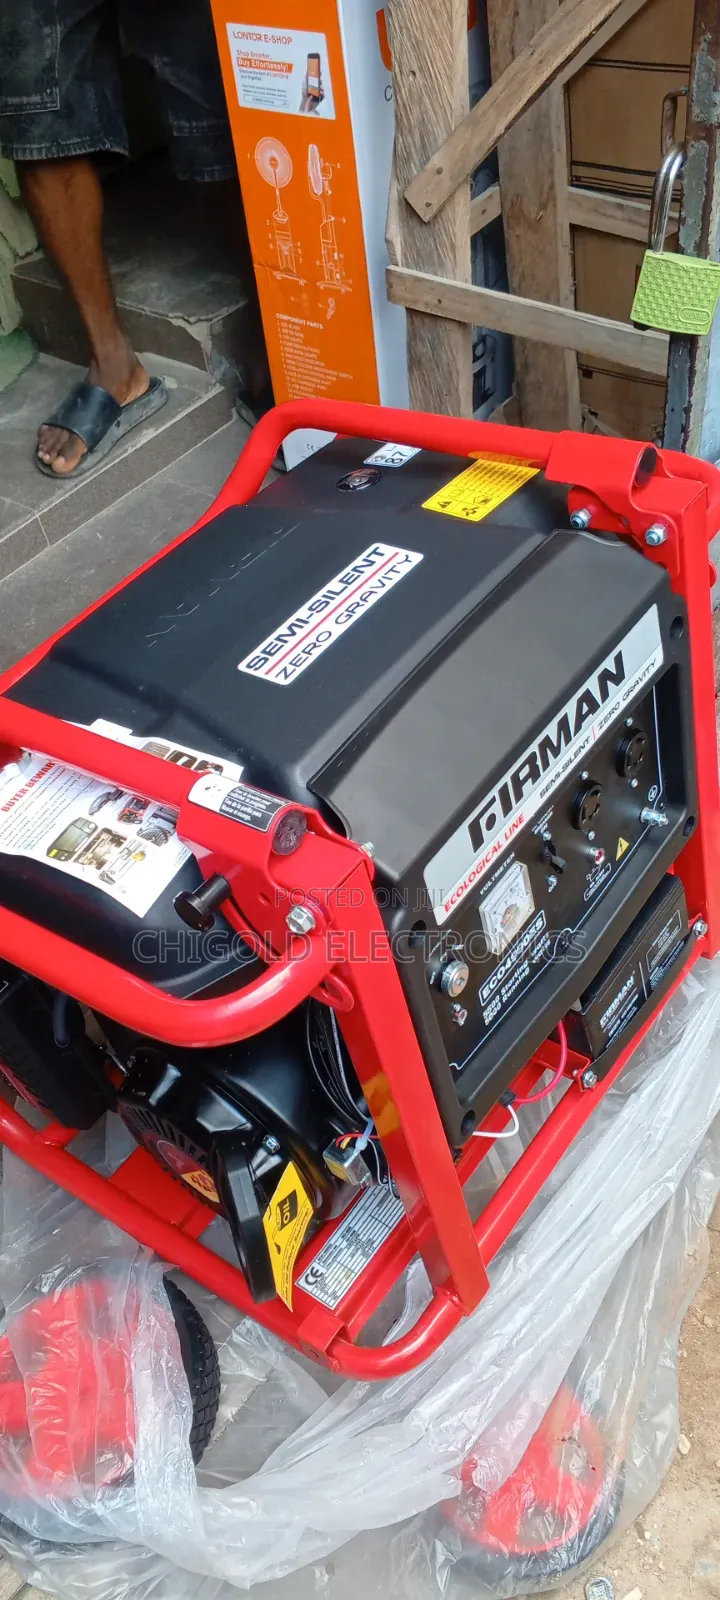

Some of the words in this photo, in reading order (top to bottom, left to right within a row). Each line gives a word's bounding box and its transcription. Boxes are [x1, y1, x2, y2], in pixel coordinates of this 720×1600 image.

[233, 30, 263, 42] LONTOR
[264, 34, 293, 45] E-SHOP
[238, 58, 251, 68] Buy
[275, 312, 307, 326] COMPONENT
[306, 319, 325, 330] PARTS
[246, 546, 386, 672] SEMI-SILENT
[275, 630, 332, 681] ZERO
[335, 553, 417, 625] GRAVITY
[597, 702, 621, 732] ZERO
[622, 657, 658, 702] GRAVITY
[467, 649, 627, 855] FIRMAN
[539, 736, 591, 799] SEMI-SILENT
[1, 786, 29, 813] BUYER
[28, 761, 56, 790] BEWAR
[443, 836, 503, 914] ECOLOGICAL
[503, 813, 526, 847] LINE
[479, 851, 516, 896] VOLTMETER
[500, 959, 530, 996] Starting
[501, 966, 531, 1010] Running
[282, 1197, 292, 1223] OIL
